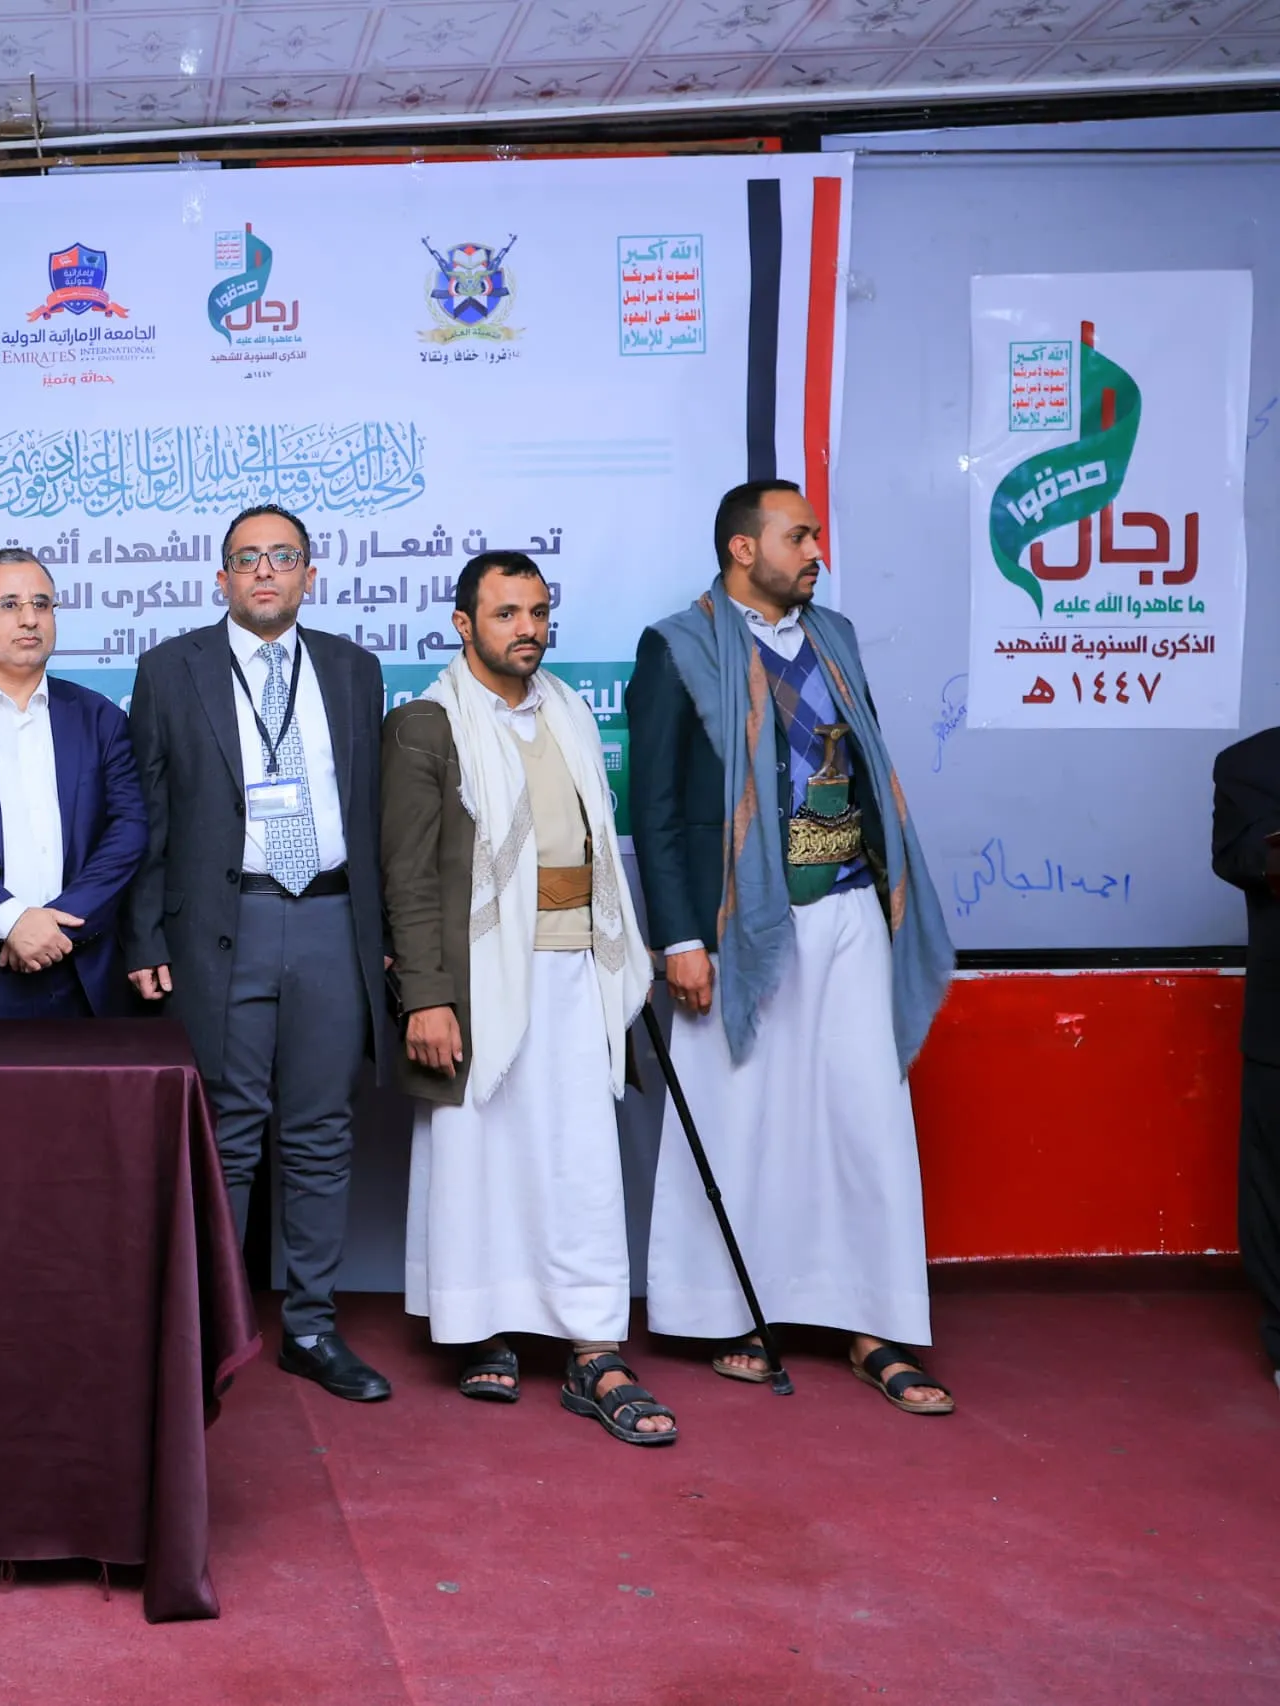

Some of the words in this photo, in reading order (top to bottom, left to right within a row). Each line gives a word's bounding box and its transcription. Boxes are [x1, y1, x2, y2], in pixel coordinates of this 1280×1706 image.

[670, 240, 699, 259] الله
[666, 267, 699, 284] الموت
[215, 280, 259, 309] صدقوا
[666, 287, 700, 304] الموت
[225, 296, 299, 332] رجال
[623, 309, 652, 326] اليهود
[1, 328, 46, 347] الدولية
[104, 324, 156, 343] الجامعة
[666, 325, 701, 349] النصر
[2, 349, 76, 368] EMIRATES
[80, 346, 155, 355] INTERNATIONAL
[210, 351, 242, 364] للشهيد
[244, 351, 278, 364] السنوية
[279, 350, 307, 363] الذكرى
[1048, 347, 1069, 360] الله
[80, 369, 115, 384] حداثة
[1043, 367, 1068, 378] الموت
[1043, 382, 1067, 393] الموت
[1006, 460, 1108, 527] صدقوا
[87, 529, 211, 564] الشهداء
[355, 524, 453, 567] شعار
[462, 527, 563, 555] تحت
[1029, 500, 1200, 585] رجال
[101, 580, 202, 617] للذكرى
[336, 576, 408, 613] احياء
[1095, 591, 1123, 613] الله
[1188, 595, 1205, 613] ما
[1053, 595, 1091, 618] عليه
[1127, 595, 1184, 619] عاهدوا
[994, 632, 1067, 660] للشهيد
[1071, 634, 1148, 660] السنوية
[1152, 633, 1215, 660] الذكرى
